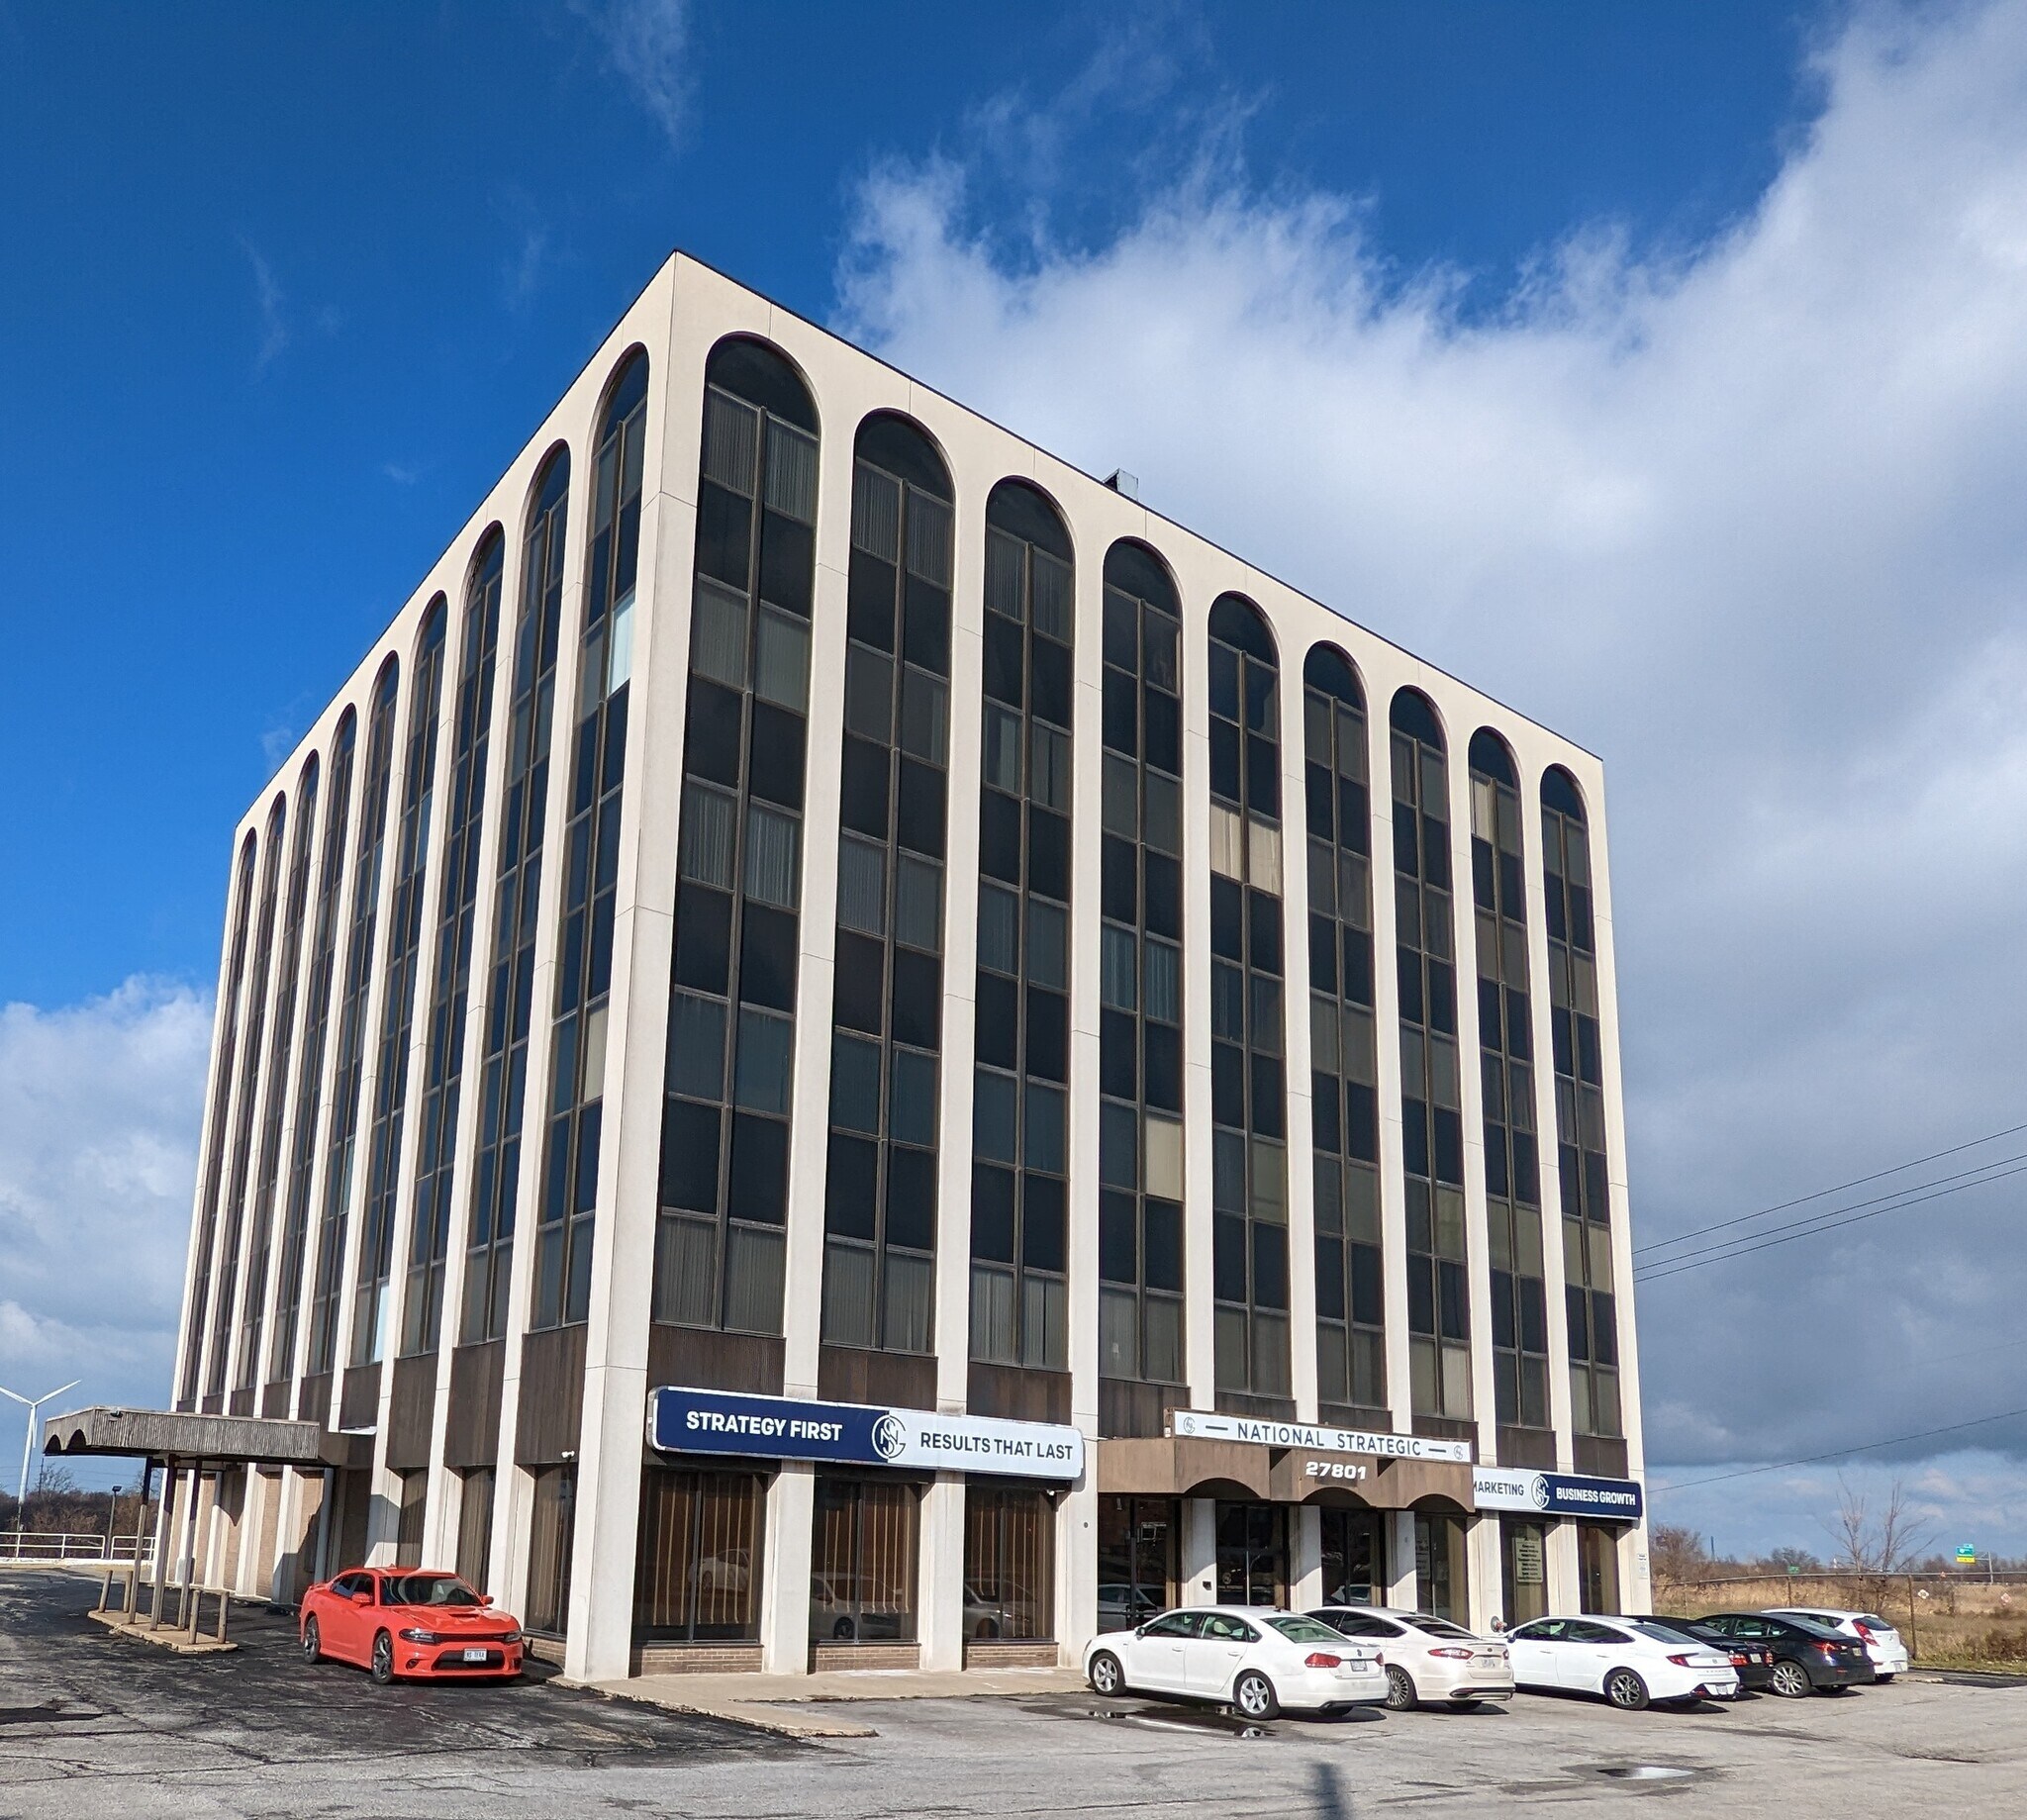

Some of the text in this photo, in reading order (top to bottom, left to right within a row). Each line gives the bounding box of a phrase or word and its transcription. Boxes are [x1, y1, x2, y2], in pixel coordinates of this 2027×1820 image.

[686, 1410, 843, 1441] STRATEGY FIRST
[1237, 1422, 1421, 1456] NATIONAL STRATEGIC
[920, 1431, 1073, 1460] RESULTS THAT LAST
[1305, 1461, 1367, 1481] 27801
[1556, 1486, 1636, 1506] BUSINESS GROWTH
